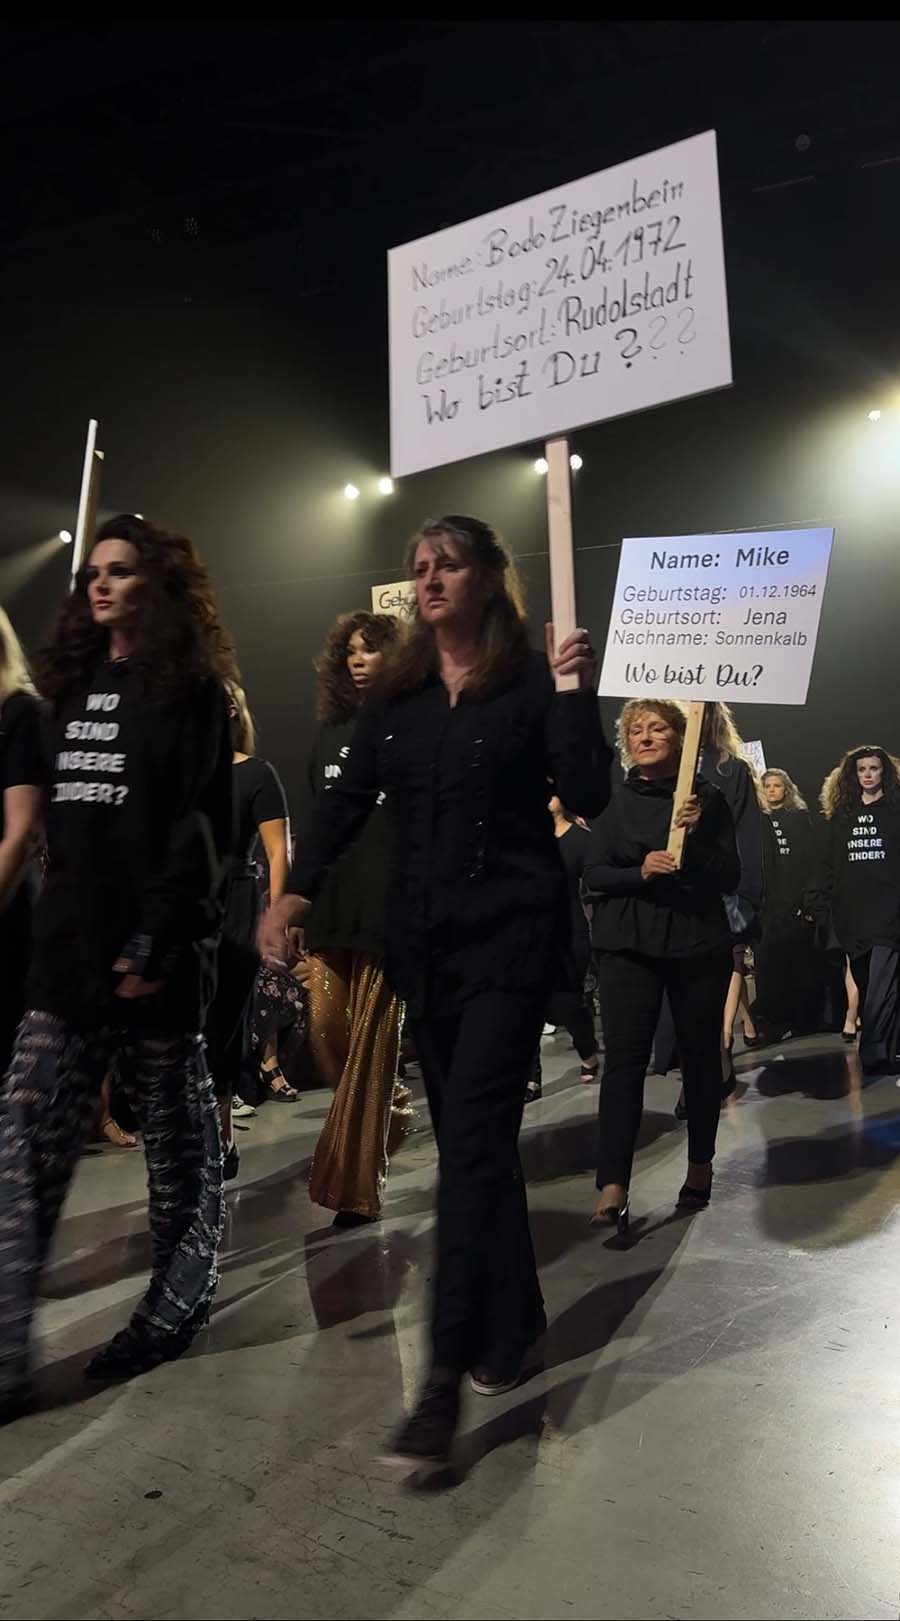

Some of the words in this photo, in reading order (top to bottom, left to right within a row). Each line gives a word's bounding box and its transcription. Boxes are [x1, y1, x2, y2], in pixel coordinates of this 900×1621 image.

[484, 216, 545, 267] Bodo
[558, 259, 695, 336] Rudolstadt
[422, 389, 460, 424] Wo
[478, 360, 532, 410] bist
[543, 350, 601, 389] Du
[650, 551, 720, 570] Name:
[735, 547, 789, 567] Mike
[623, 585, 727, 604] Geburtstag:
[739, 584, 817, 599] 01.12.1964
[620, 608, 721, 625] Geburtsort:
[743, 608, 787, 625] Jena
[613, 630, 708, 646] Nachname:
[715, 631, 808, 646] Sonnenkalb
[625, 662, 659, 684] Wo
[663, 664, 707, 685] bist
[716, 664, 763, 687] Du?
[86, 693, 120, 711] WO
[65, 720, 119, 741] SIND
[857, 814, 874, 823] WO
[847, 838, 882, 850] NSERE
